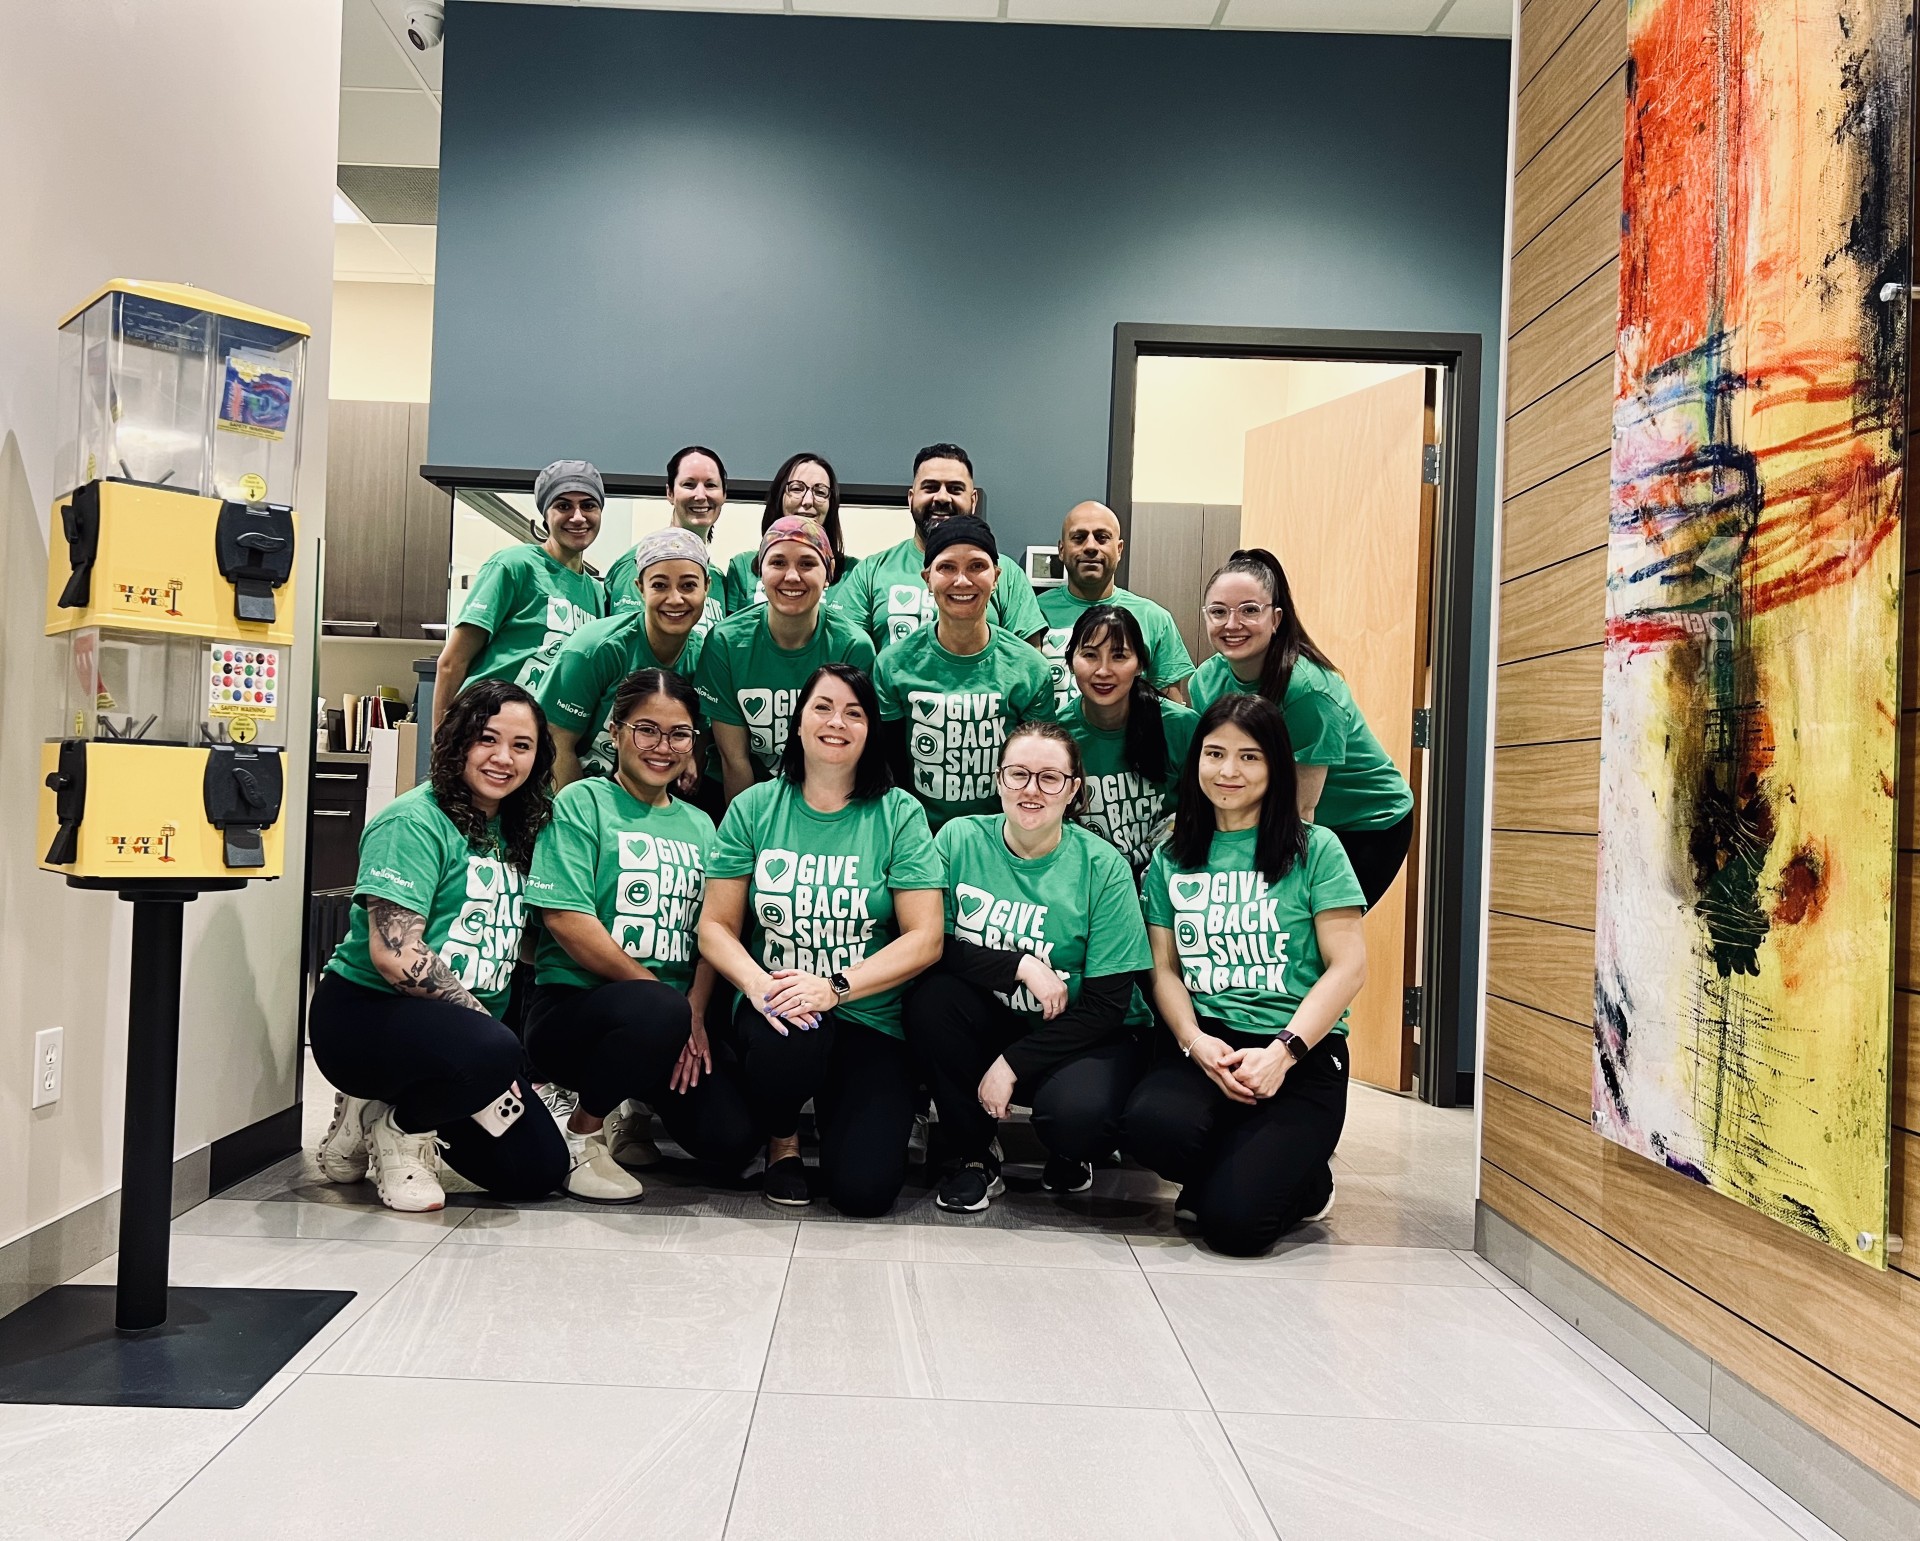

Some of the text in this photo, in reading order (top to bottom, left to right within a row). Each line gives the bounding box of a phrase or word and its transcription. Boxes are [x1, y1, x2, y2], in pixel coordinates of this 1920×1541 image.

[240, 706, 267, 714] WARNING
[774, 689, 802, 717] GI
[946, 693, 1002, 720] GIVE
[946, 716, 1007, 749] BACK
[945, 747, 1000, 774] SMIL
[655, 836, 704, 871] GIVE
[797, 854, 860, 887] GIVE
[795, 885, 870, 920] BACK
[1210, 871, 1269, 904] GIVE
[484, 892, 528, 928] BAC
[988, 899, 1048, 939] GIVE
[1207, 898, 1281, 935] BACK
[794, 918, 877, 949] SMILE
[1208, 932, 1290, 966] SMILE
[1212, 963, 1288, 995] BACK
